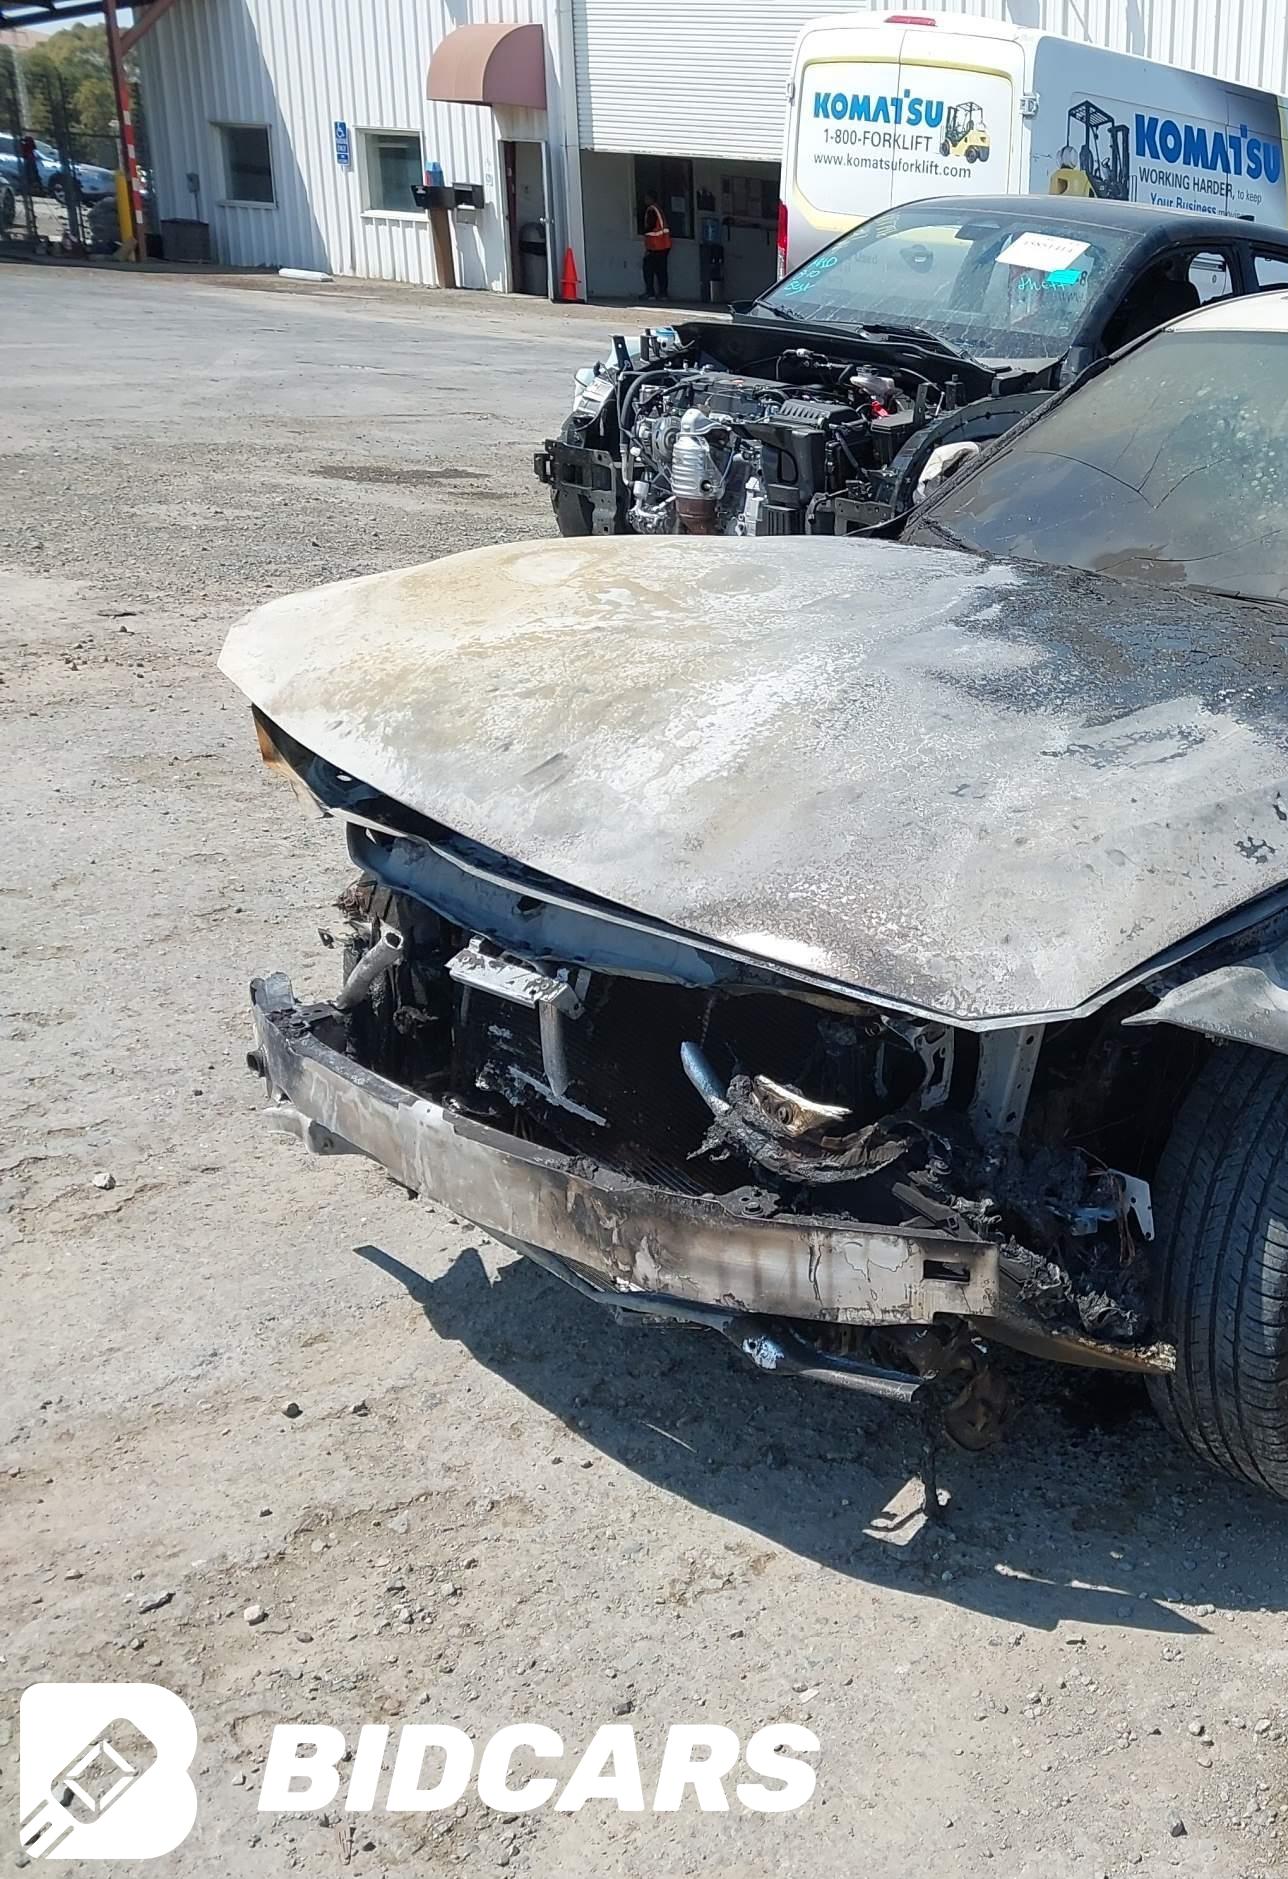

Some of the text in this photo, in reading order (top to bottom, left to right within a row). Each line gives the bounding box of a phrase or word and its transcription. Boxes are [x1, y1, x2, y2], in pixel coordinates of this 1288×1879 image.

[813, 89, 944, 128] KOMATSU
[824, 128, 933, 152] 1-800-FORKLIFT
[1135, 113, 1281, 183] KOMATSU
[813, 152, 971, 178] www.komatsuforklift.com
[1139, 166, 1262, 206] WORKING HARDER, to keep
[1150, 191, 1174, 208] Your
[1175, 195, 1217, 215] Business
